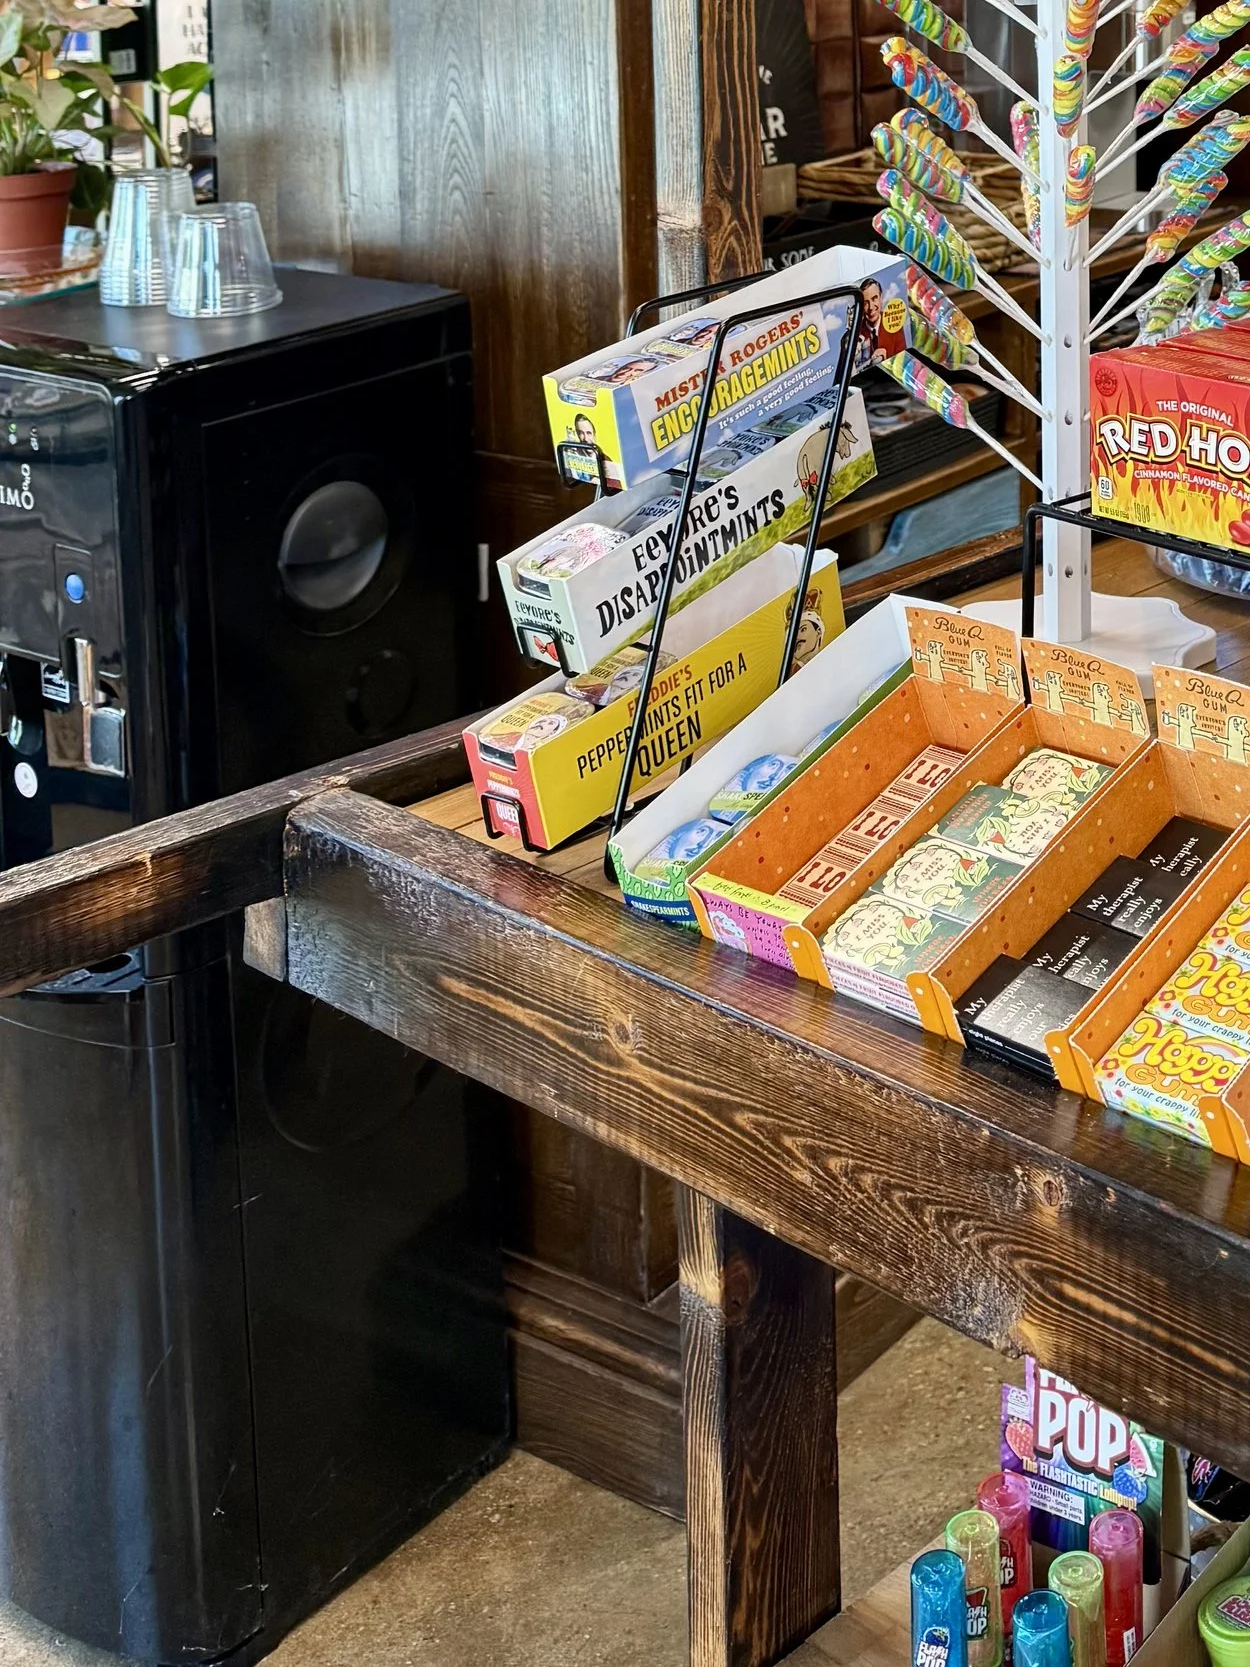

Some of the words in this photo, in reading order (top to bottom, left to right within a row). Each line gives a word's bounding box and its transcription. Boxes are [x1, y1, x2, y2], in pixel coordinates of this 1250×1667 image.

[730, 310, 805, 366] ROGERS'
[718, 415, 735, 430] It's
[735, 403, 756, 420] such
[763, 387, 782, 406] good
[765, 399, 782, 415] very
[782, 386, 804, 403] good
[1156, 400, 1178, 412] THE
[1181, 402, 1234, 427] ORIGINAL
[1099, 419, 1178, 458] RED
[1134, 470, 1180, 481] CINNAMON
[1181, 473, 1229, 493] FLAVORED
[684, 679, 704, 710] FIT
[708, 659, 735, 694] FOR
[738, 652, 747, 679] A
[1185, 677, 1224, 700] Blue
[1224, 689, 1245, 707] Q
[1203, 699, 1228, 714] GUM
[636, 710, 703, 777] QUEEN
[1086, 893, 1109, 912] My
[1102, 876, 1144, 917] therapist
[1118, 895, 1145, 923] really
[862, 913, 886, 936] MISS
[1133, 898, 1163, 929] enjoys
[1225, 944, 1238, 954] for
[1118, 1016, 1242, 1095] Happ
[1114, 1077, 1130, 1088] for
[1132, 1084, 1155, 1100] your
[1155, 1095, 1188, 1112] crappy
[1039, 1389, 1128, 1470] POP
[1022, 1457, 1038, 1473] The
[1040, 1463, 1098, 1495] FLASHTASTIC
[1100, 1484, 1137, 1511] Lollipop!
[1030, 1480, 1073, 1503] WARNING:
[920, 1642, 948, 1658] FLASH
